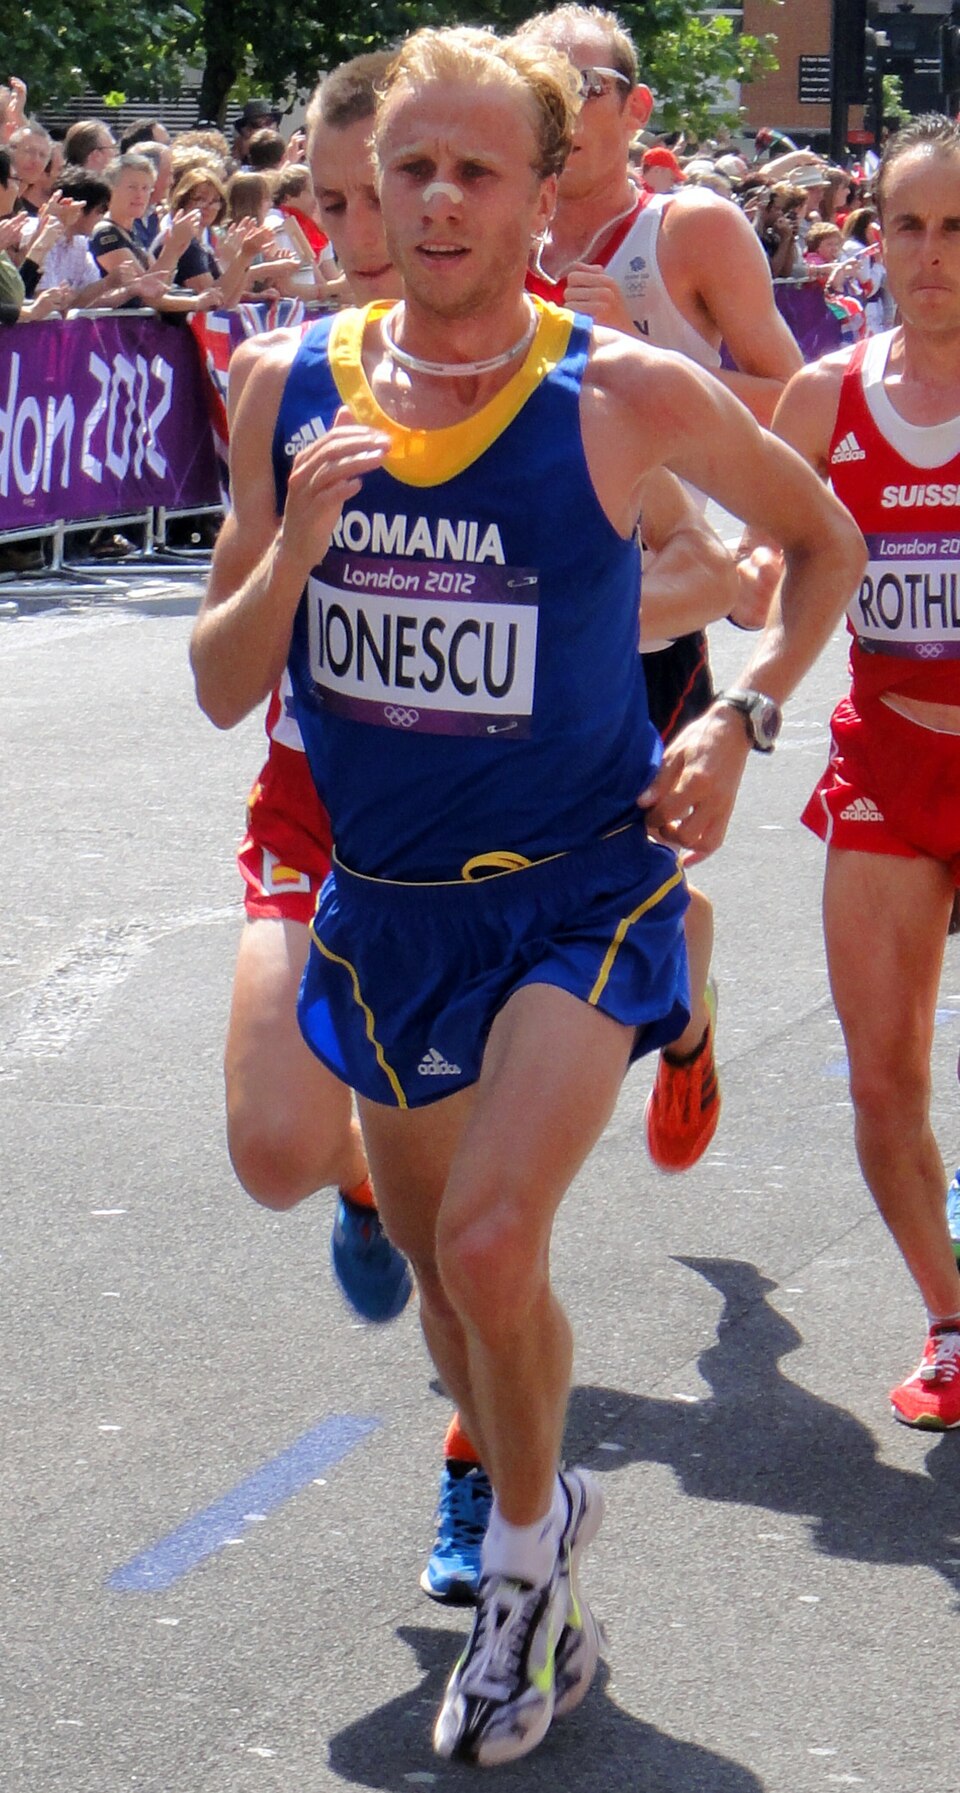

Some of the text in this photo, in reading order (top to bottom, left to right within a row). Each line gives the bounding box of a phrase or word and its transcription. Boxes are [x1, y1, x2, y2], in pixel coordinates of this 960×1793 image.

[81, 351, 174, 483] 2012
[831, 449, 866, 464] adidas
[880, 539, 937, 555] London
[343, 563, 476, 595] London 2012
[859, 573, 960, 630] ROTHL
[317, 597, 518, 699] IONESCU
[840, 808, 884, 822] adidas
[418, 1060, 462, 1075] adidas
